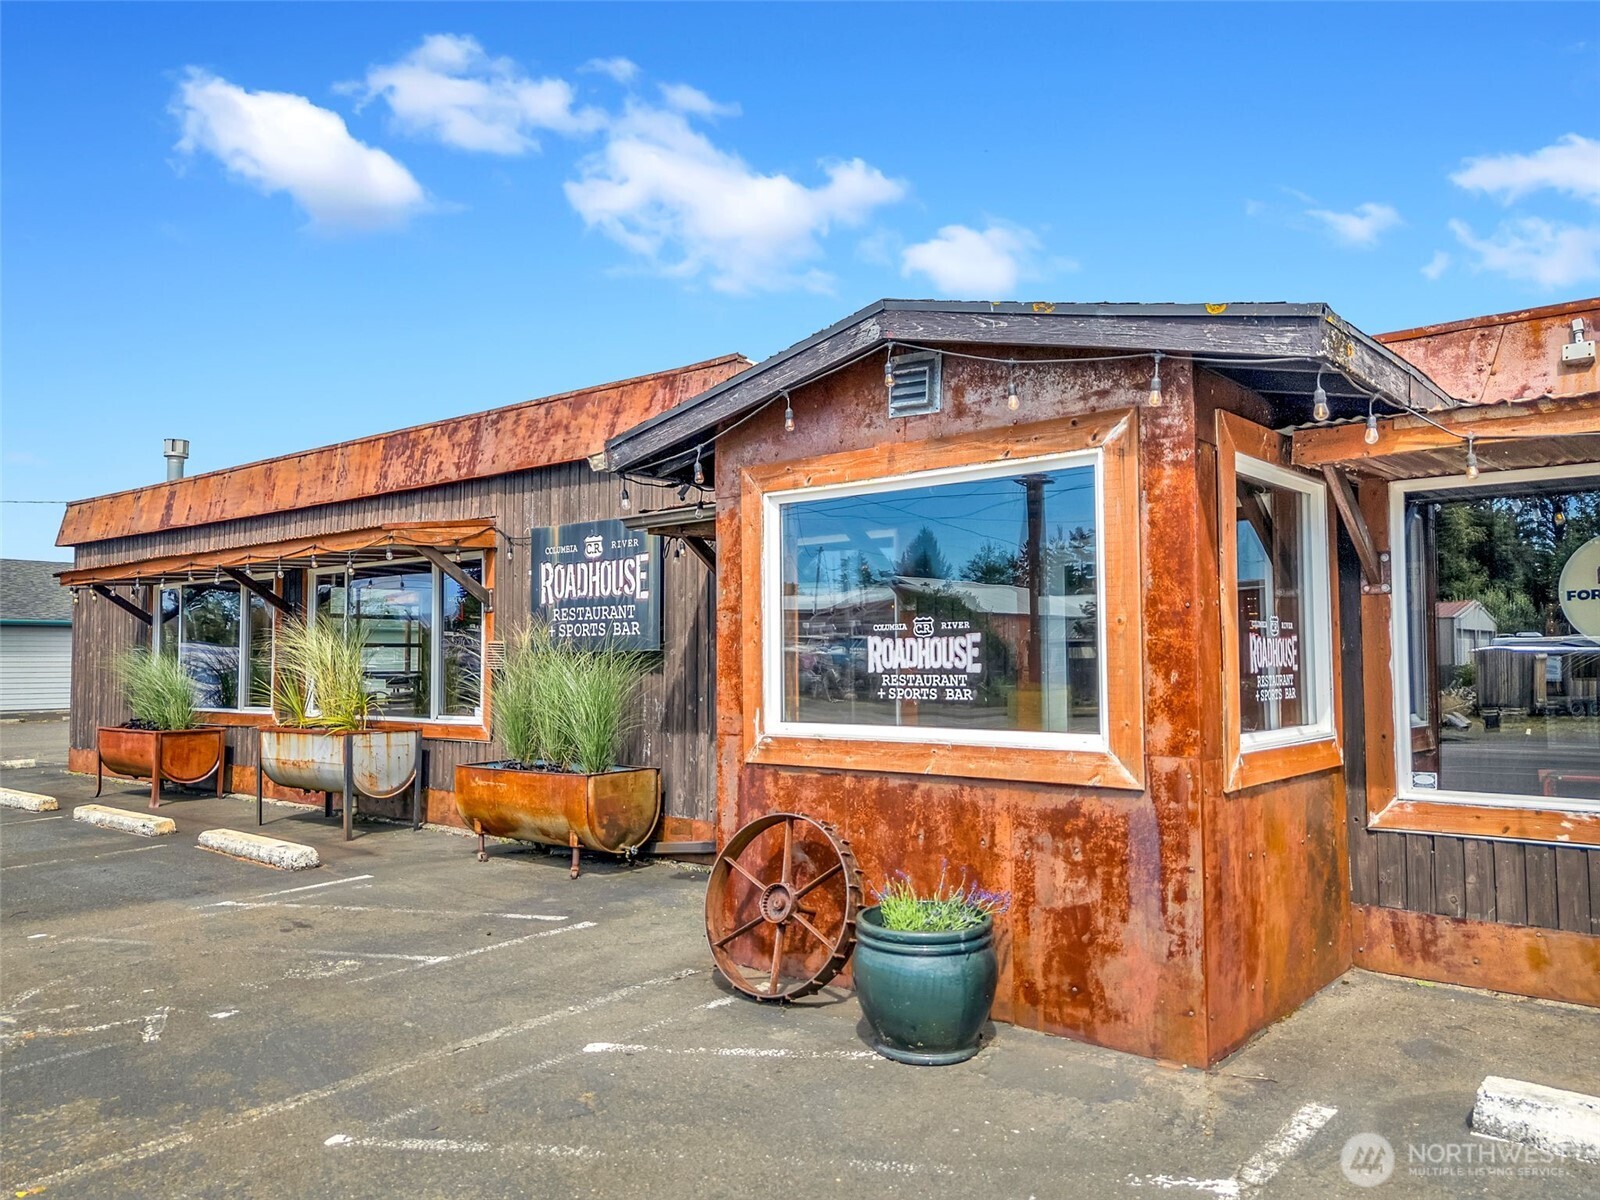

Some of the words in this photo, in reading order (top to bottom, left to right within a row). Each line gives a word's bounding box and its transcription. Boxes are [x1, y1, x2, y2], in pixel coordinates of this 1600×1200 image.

[545, 545, 578, 555] COLUMBIA
[611, 539, 639, 549] RIVER
[541, 554, 649, 605] ROADHOUSE
[553, 605, 636, 621] RESTAURANT
[558, 622, 606, 637] SPORTS
[613, 621, 641, 636] BAR
[868, 632, 982, 673] ROADHOUSE
[1249, 632, 1298, 674] ROADHOUSE
[881, 674, 968, 687] RESTAURANT
[1257, 674, 1294, 687] RESTAURANT
[888, 688, 938, 700] SPORTS
[945, 688, 973, 701] BAR
[1284, 688, 1296, 699] BAR
